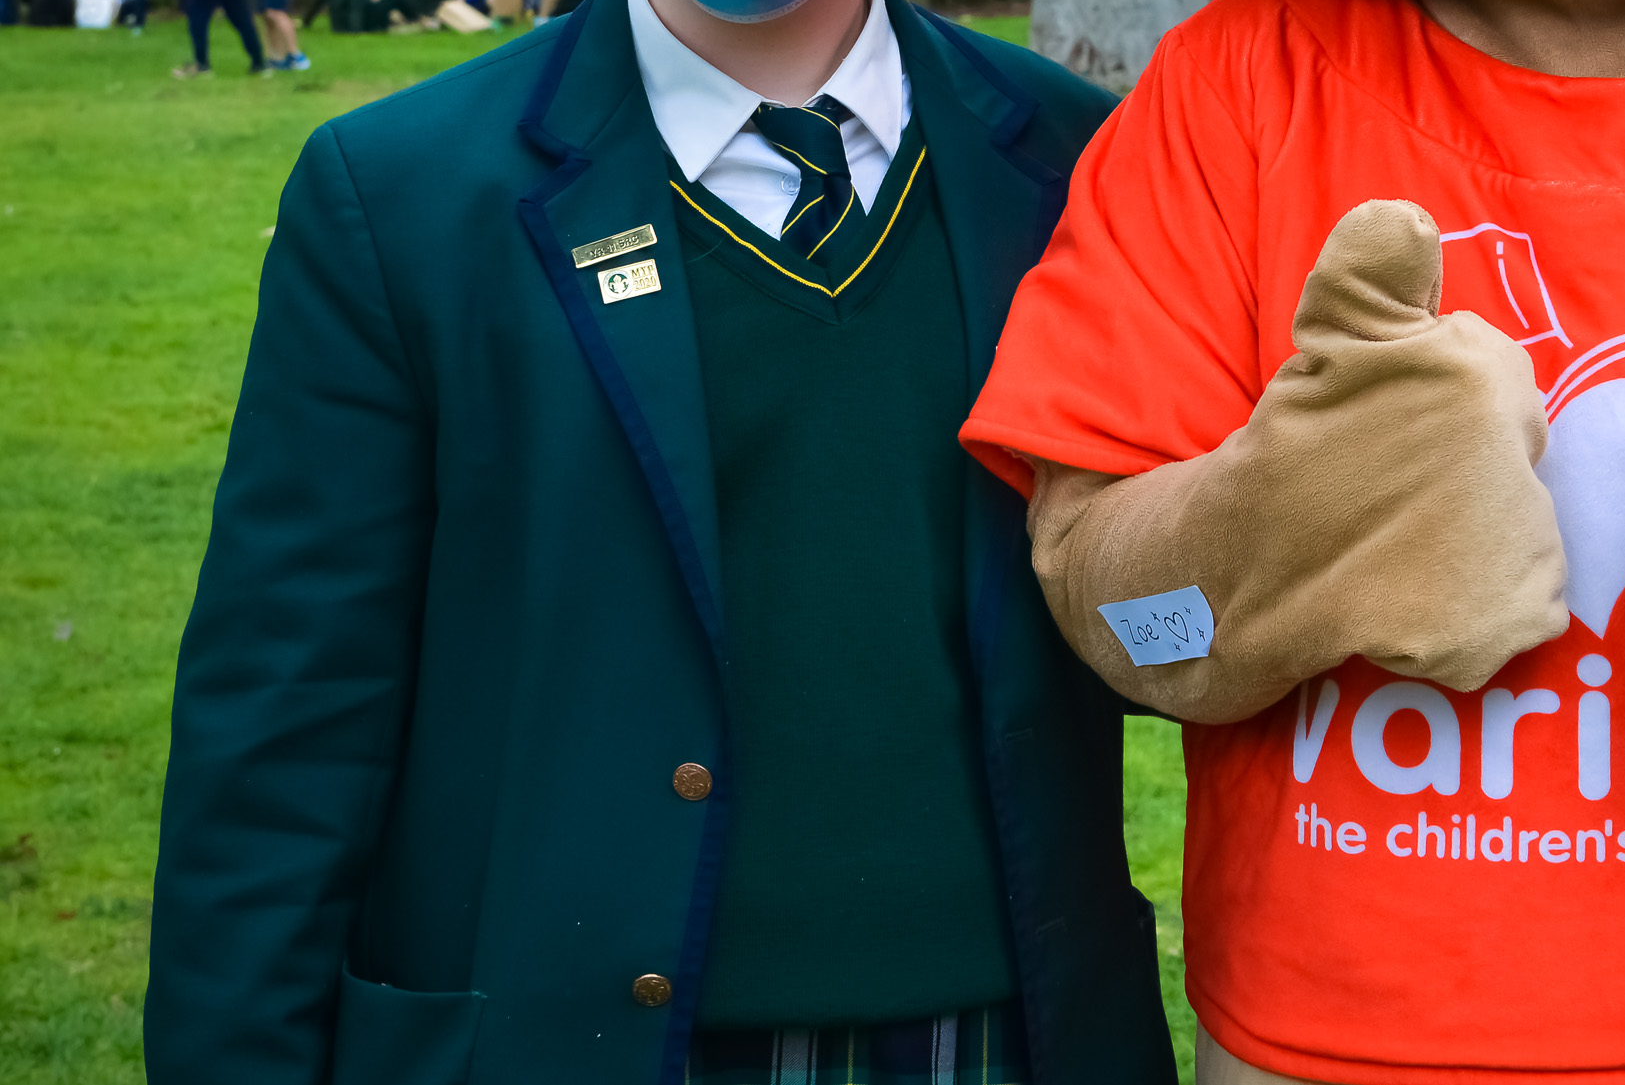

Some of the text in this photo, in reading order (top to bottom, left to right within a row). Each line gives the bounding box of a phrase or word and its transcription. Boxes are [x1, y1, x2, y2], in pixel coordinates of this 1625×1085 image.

[633, 276, 657, 291] 2020
[1120, 619, 1160, 646] Zoe
[1295, 803, 1367, 856] the
